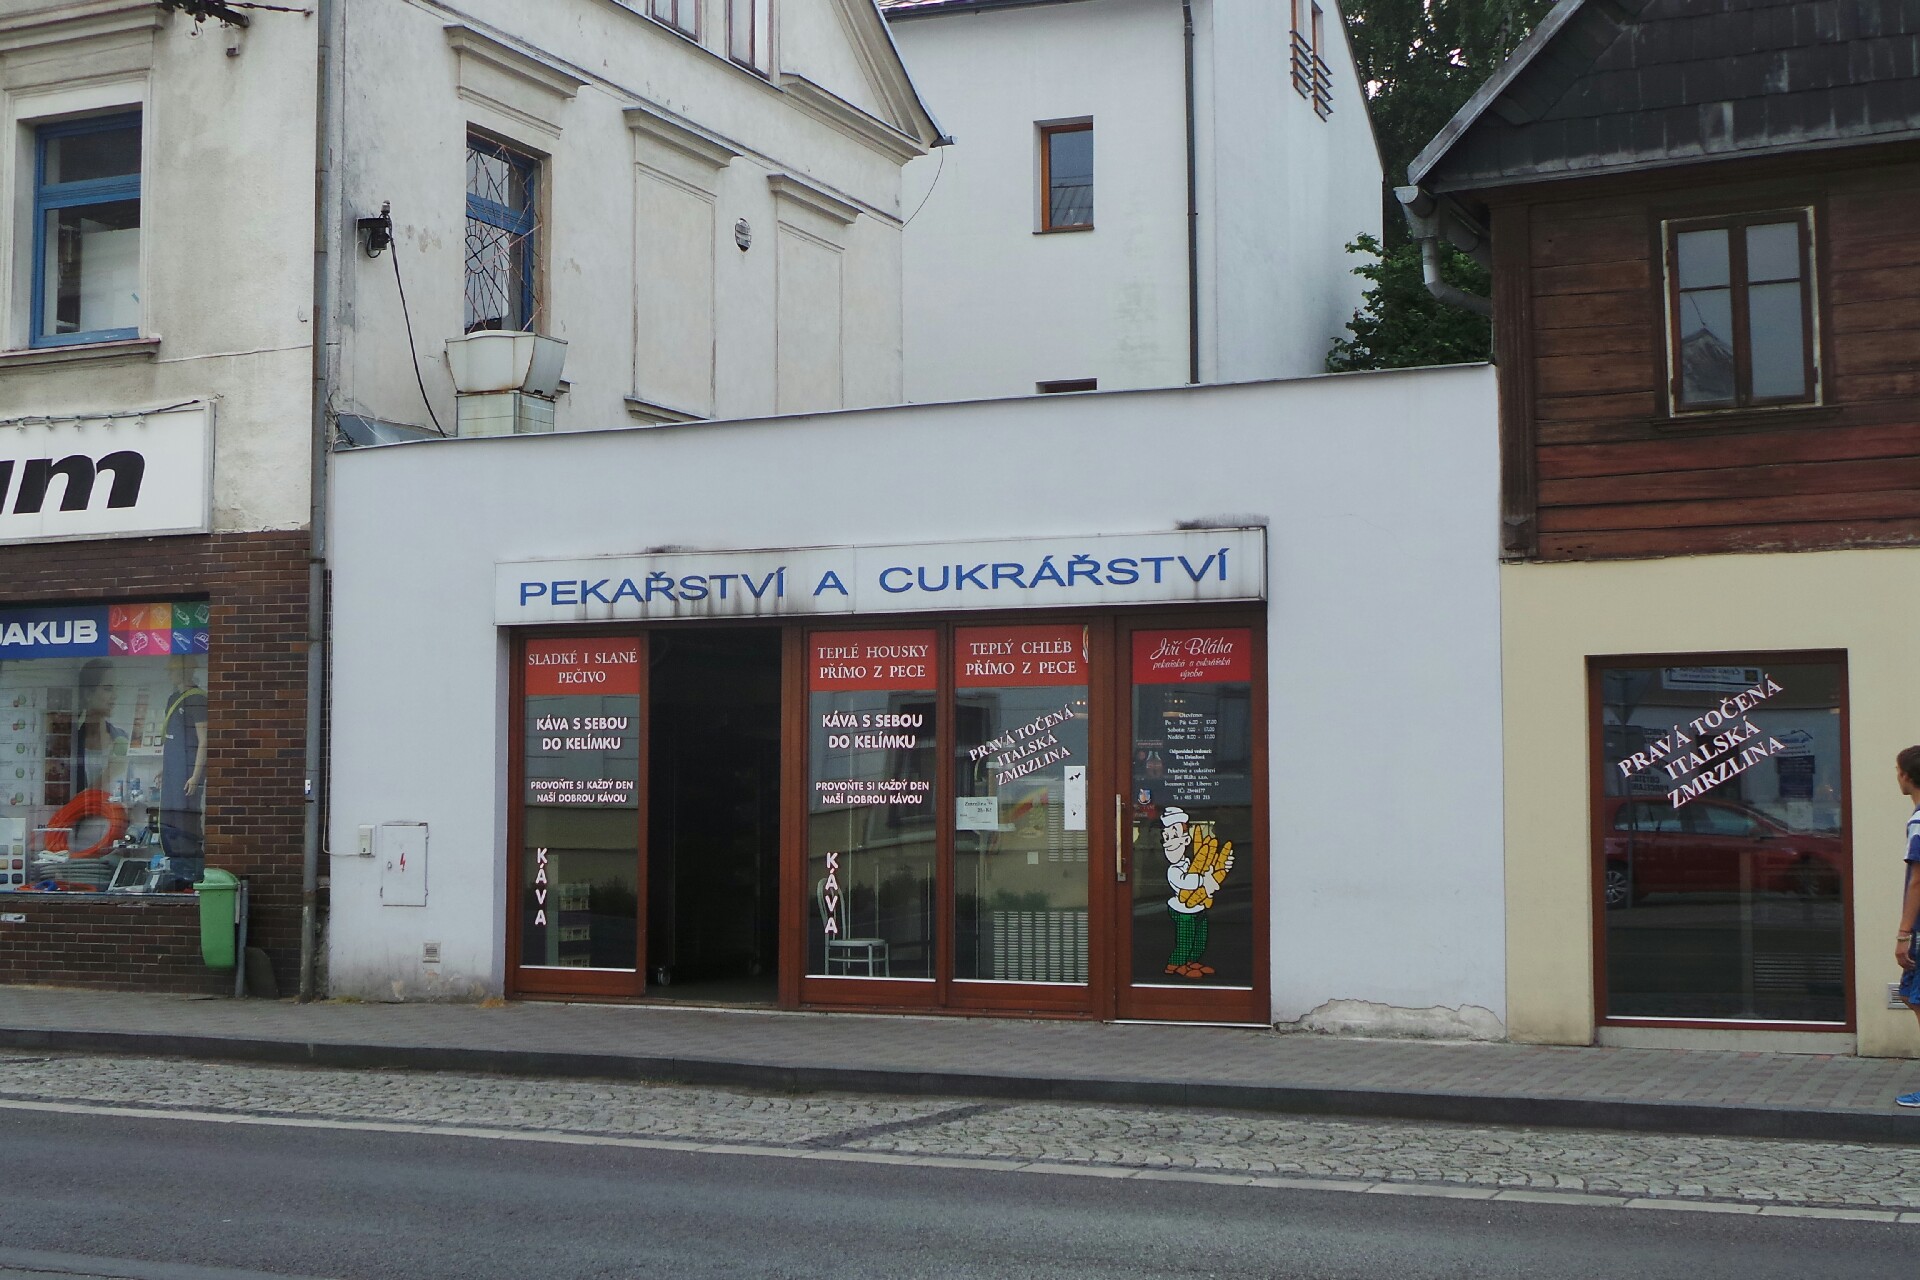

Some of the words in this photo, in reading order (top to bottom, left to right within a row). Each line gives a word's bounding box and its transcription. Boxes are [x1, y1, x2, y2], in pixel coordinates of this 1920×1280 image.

[519, 567, 786, 606] PEKAŘSTVÍ
[814, 570, 848, 596] A
[879, 547, 1229, 593] CUKRÁŘSTVÍ
[818, 643, 859, 659] TEPLÉ
[866, 645, 929, 659] HOUSKY
[970, 639, 1014, 656] TEPLÝ
[1022, 637, 1073, 654] CHLÉB
[1150, 638, 1182, 660] Jiří
[1185, 637, 1233, 655] Bláha
[528, 650, 577, 665] SLADKÉ
[584, 652, 589, 664] I
[594, 649, 638, 664] SLANÉ
[819, 663, 866, 679] PŘÍMO
[873, 665, 883, 678] Z
[889, 664, 926, 678] PECE
[965, 659, 1015, 676] PŘÍMO
[1022, 662, 1032, 675] Z
[1039, 661, 1077, 675] PECE
[1180, 668, 1203, 680] výroba
[558, 669, 606, 684] PEČIVO
[536, 714, 570, 731] KÁVA
[573, 717, 582, 730] S
[584, 716, 627, 730] SEBOU
[822, 712, 859, 728] KÁVA
[862, 714, 871, 728] S
[874, 713, 923, 728] SEBOU
[1618, 724, 1691, 778] PRAVÁ
[1689, 674, 1783, 735] TOČENÁ
[828, 734, 850, 749] DO
[854, 732, 916, 749] KELÍMKU
[969, 729, 1016, 761] PRAVÁ
[1014, 703, 1075, 740] TOČENÁ
[542, 737, 562, 750] DO
[566, 734, 621, 750] KELÍMKU
[997, 730, 1059, 767] ITALSKÁ
[1664, 716, 1761, 780] ITALSKÁ
[995, 746, 1071, 786] ZMRZLINA
[1667, 737, 1787, 809] ZMRZLINA
[530, 779, 574, 790] PROVOŇTE
[576, 781, 584, 790] SI
[586, 778, 613, 790] KAŽDÝ
[615, 780, 633, 790] DEN
[816, 779, 864, 791] PROVOŇTE
[866, 782, 875, 790] SI
[877, 778, 908, 790] KAŽDÝ
[910, 782, 929, 790] DEN
[537, 792, 556, 803] NAŠÍ
[558, 794, 592, 803] DOBROU
[592, 792, 626, 803] KÁVOU
[822, 792, 844, 804] NAŠÍ
[846, 795, 886, 804] DOBROU
[890, 792, 922, 804] KÁVOU
[535, 847, 547, 926] KÁVA
[824, 852, 838, 934] KÁVA
